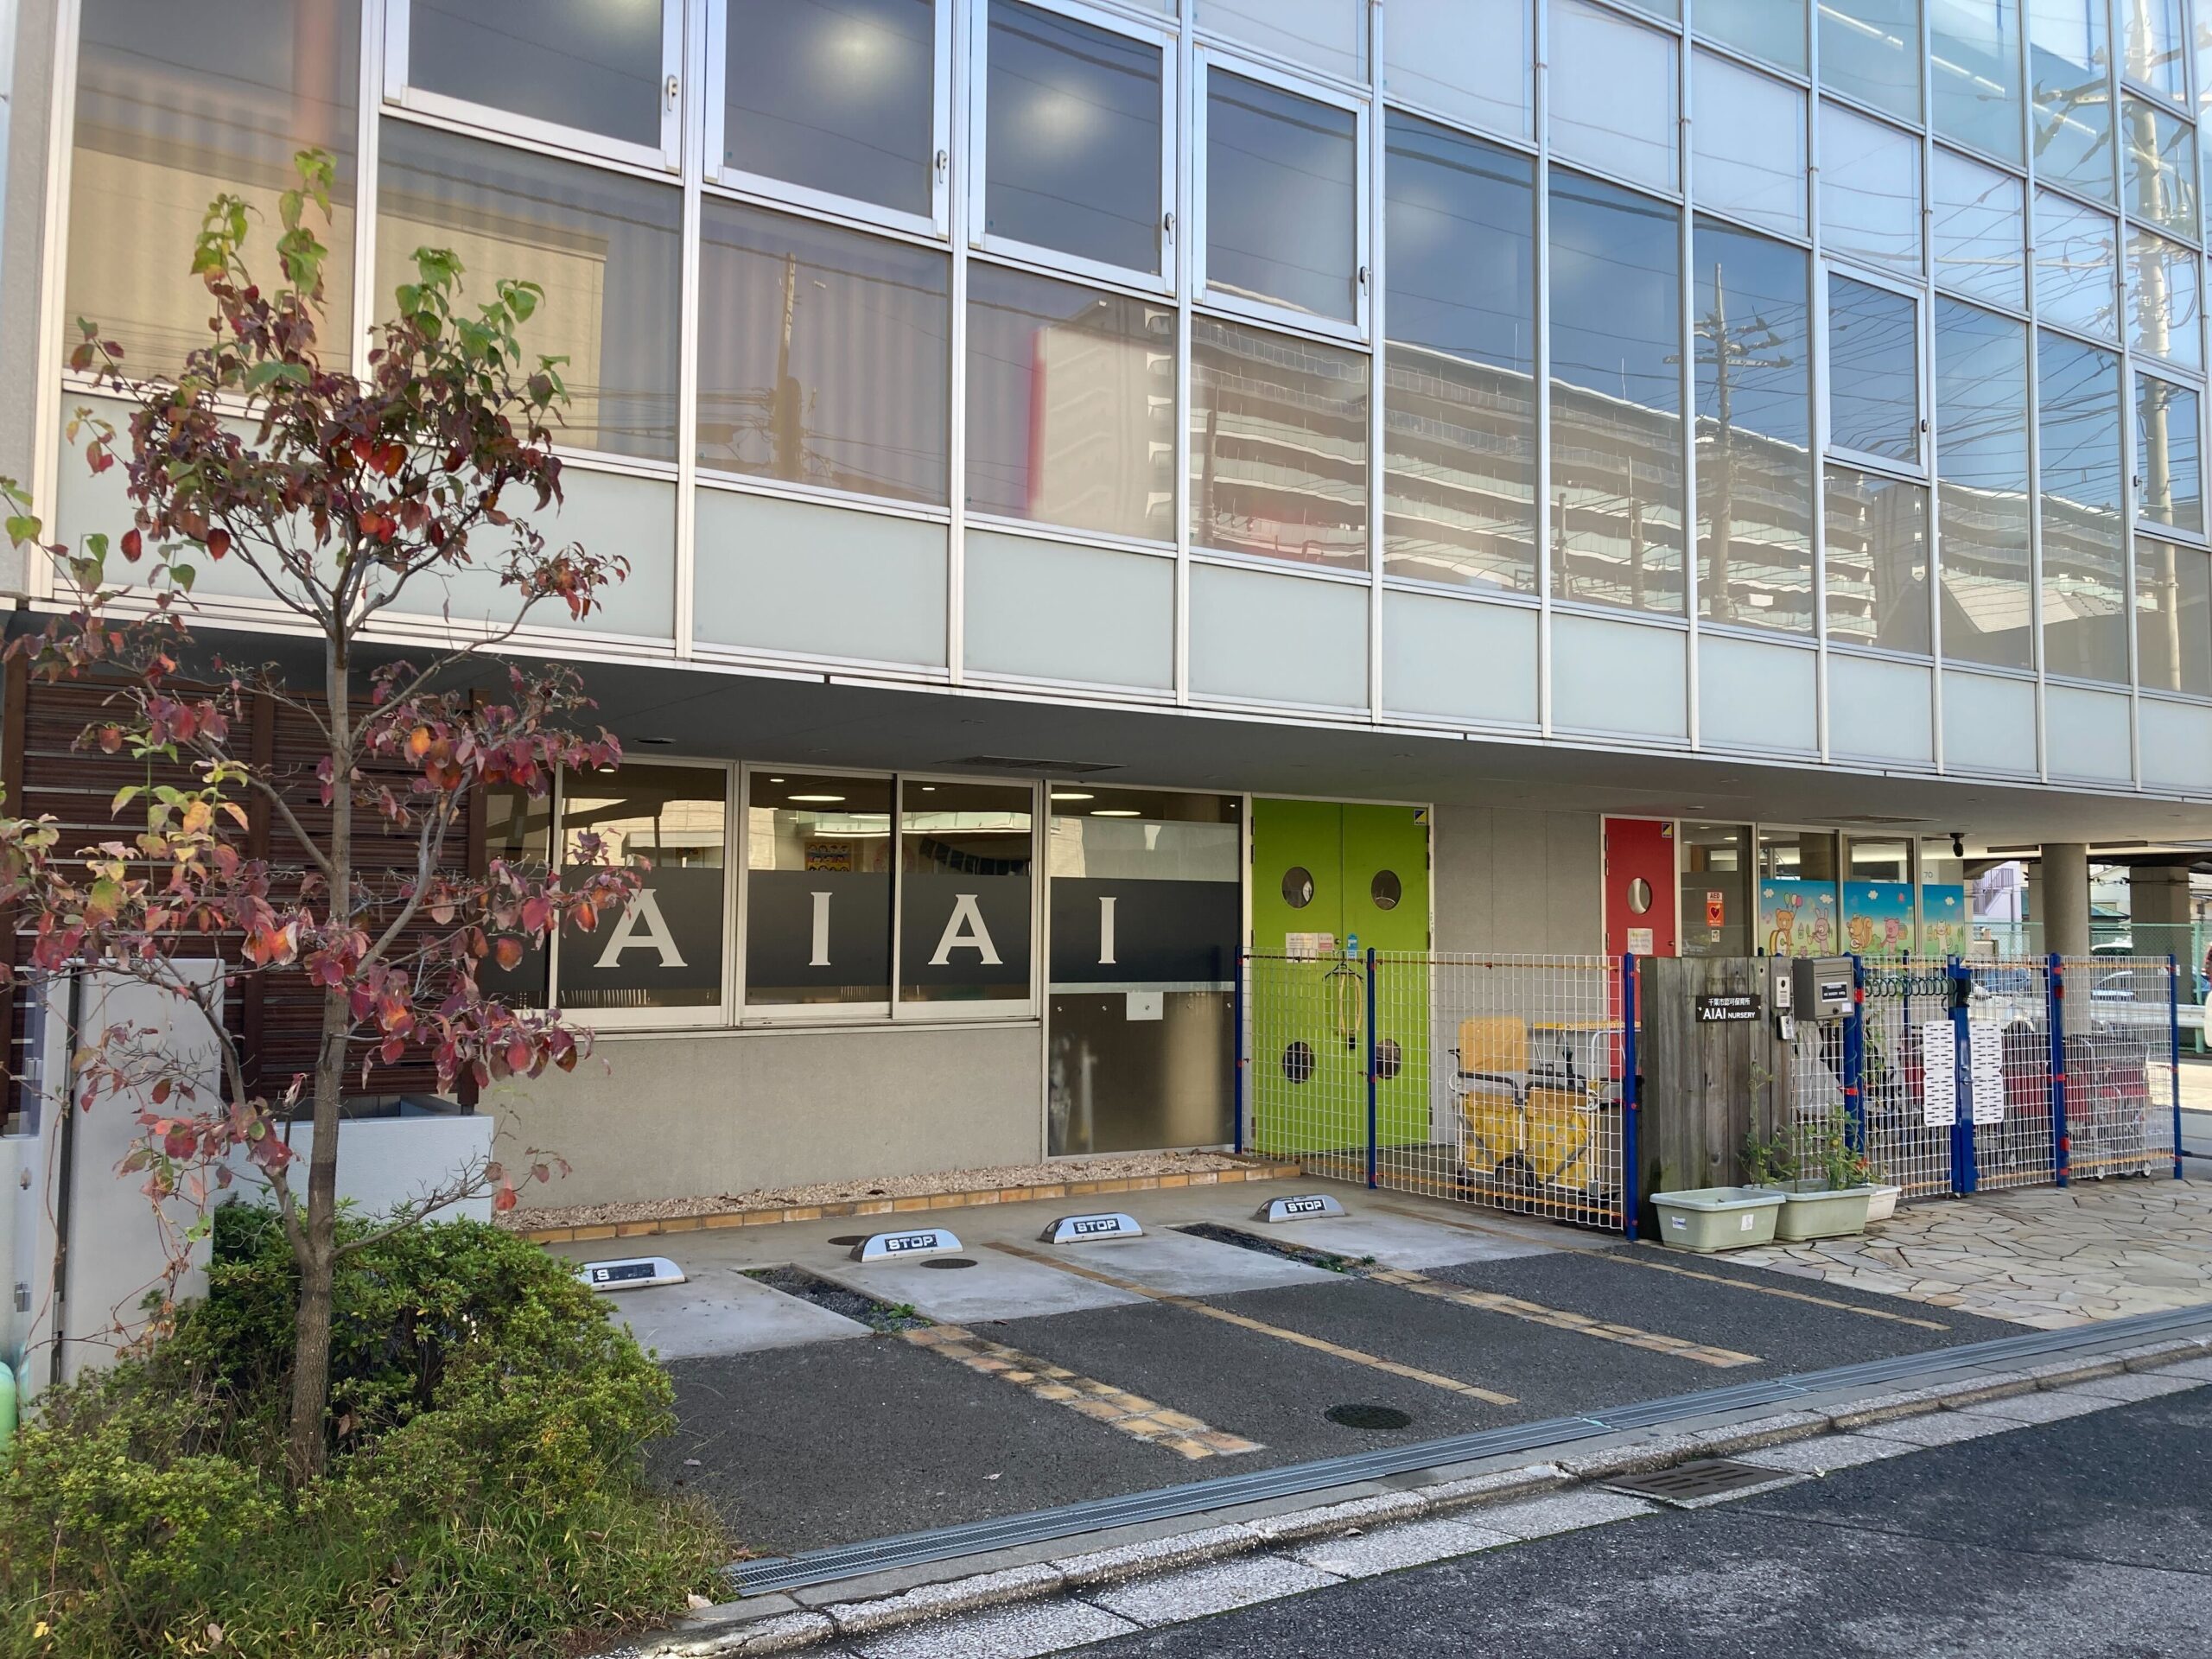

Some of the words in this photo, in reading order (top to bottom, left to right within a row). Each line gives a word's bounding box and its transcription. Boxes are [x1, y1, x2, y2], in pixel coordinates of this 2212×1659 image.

[1702, 1007, 1726, 1020] AIAI
[1287, 1201, 1322, 1211] STOP
[1077, 1219, 1116, 1232] STOP
[888, 1236, 934, 1249] STOP
